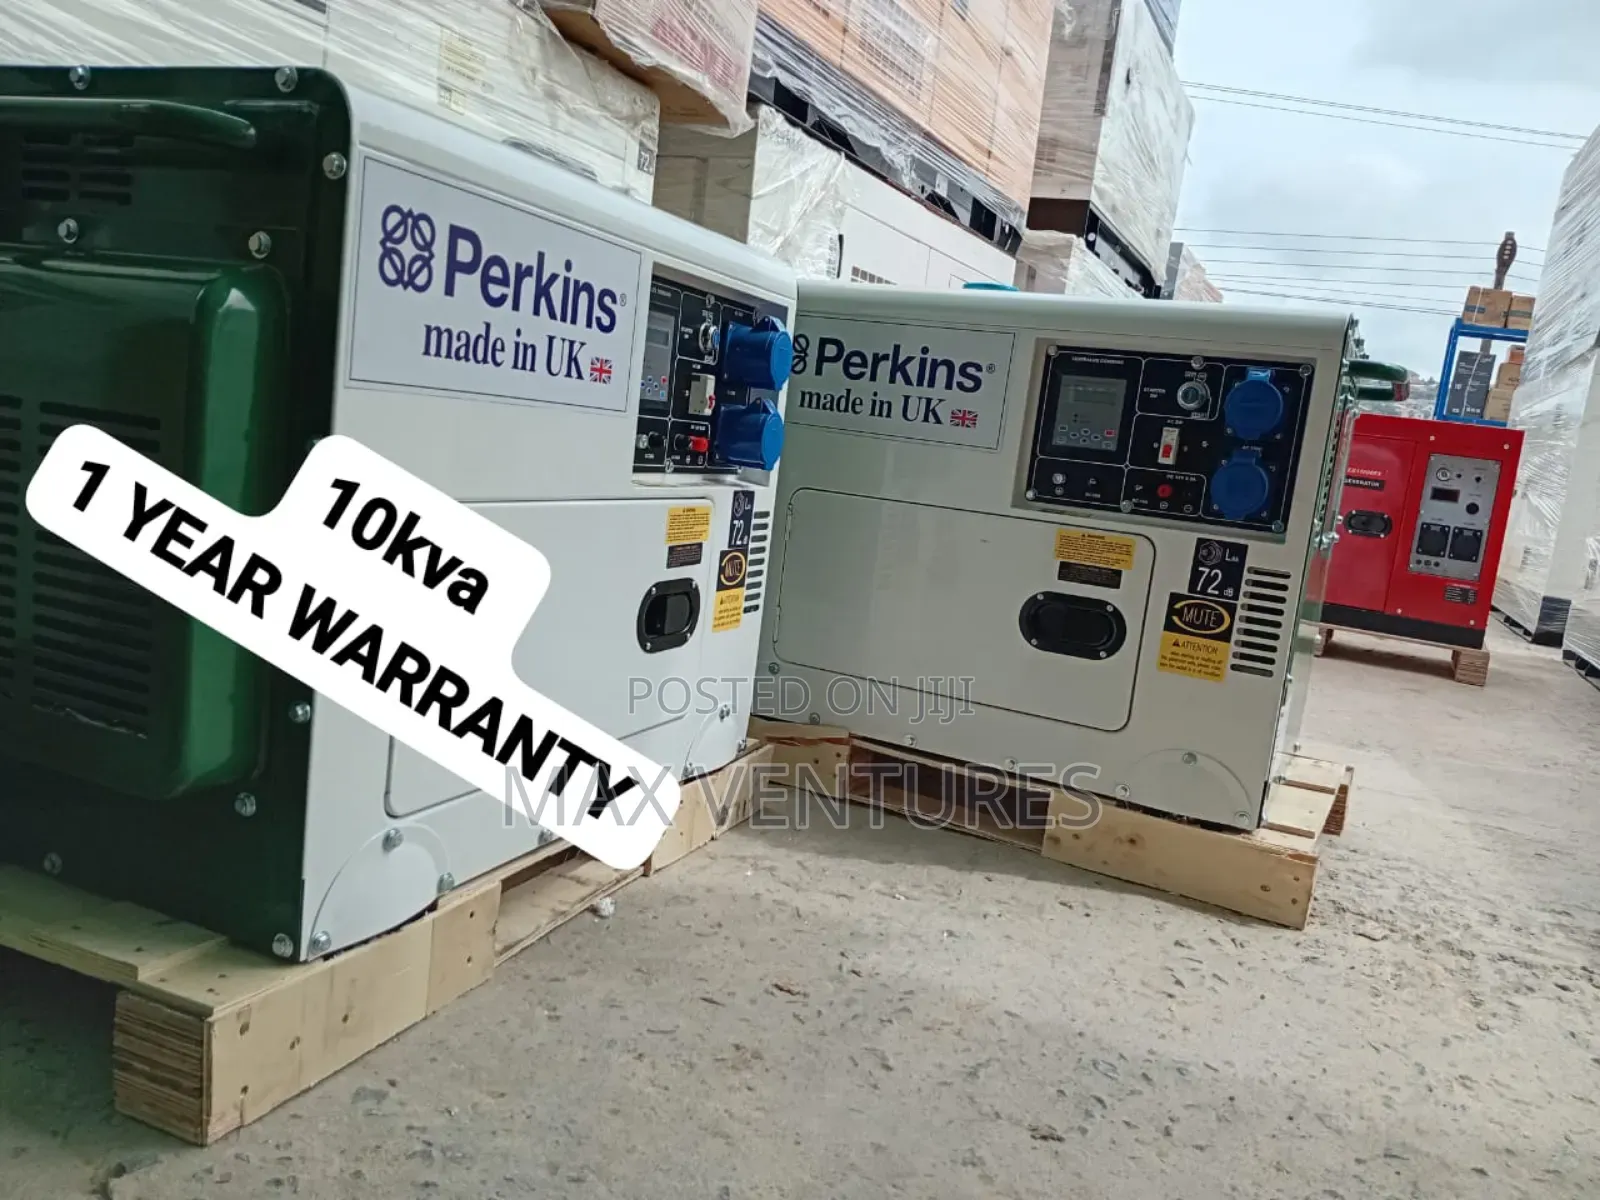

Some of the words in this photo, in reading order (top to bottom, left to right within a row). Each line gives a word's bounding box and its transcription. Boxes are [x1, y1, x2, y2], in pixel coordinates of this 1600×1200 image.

[444, 223, 618, 335] Perkins
[422, 322, 505, 368] made
[512, 327, 538, 372] in
[545, 334, 588, 381] UK
[814, 336, 984, 394] Perkins
[798, 388, 864, 415] made
[868, 391, 893, 419] in
[901, 394, 947, 425] UK
[731, 519, 745, 546] 72
[1196, 566, 1223, 595] 72
[1181, 605, 1221, 628] MUTE
[1181, 640, 1219, 656] ATTENTION
